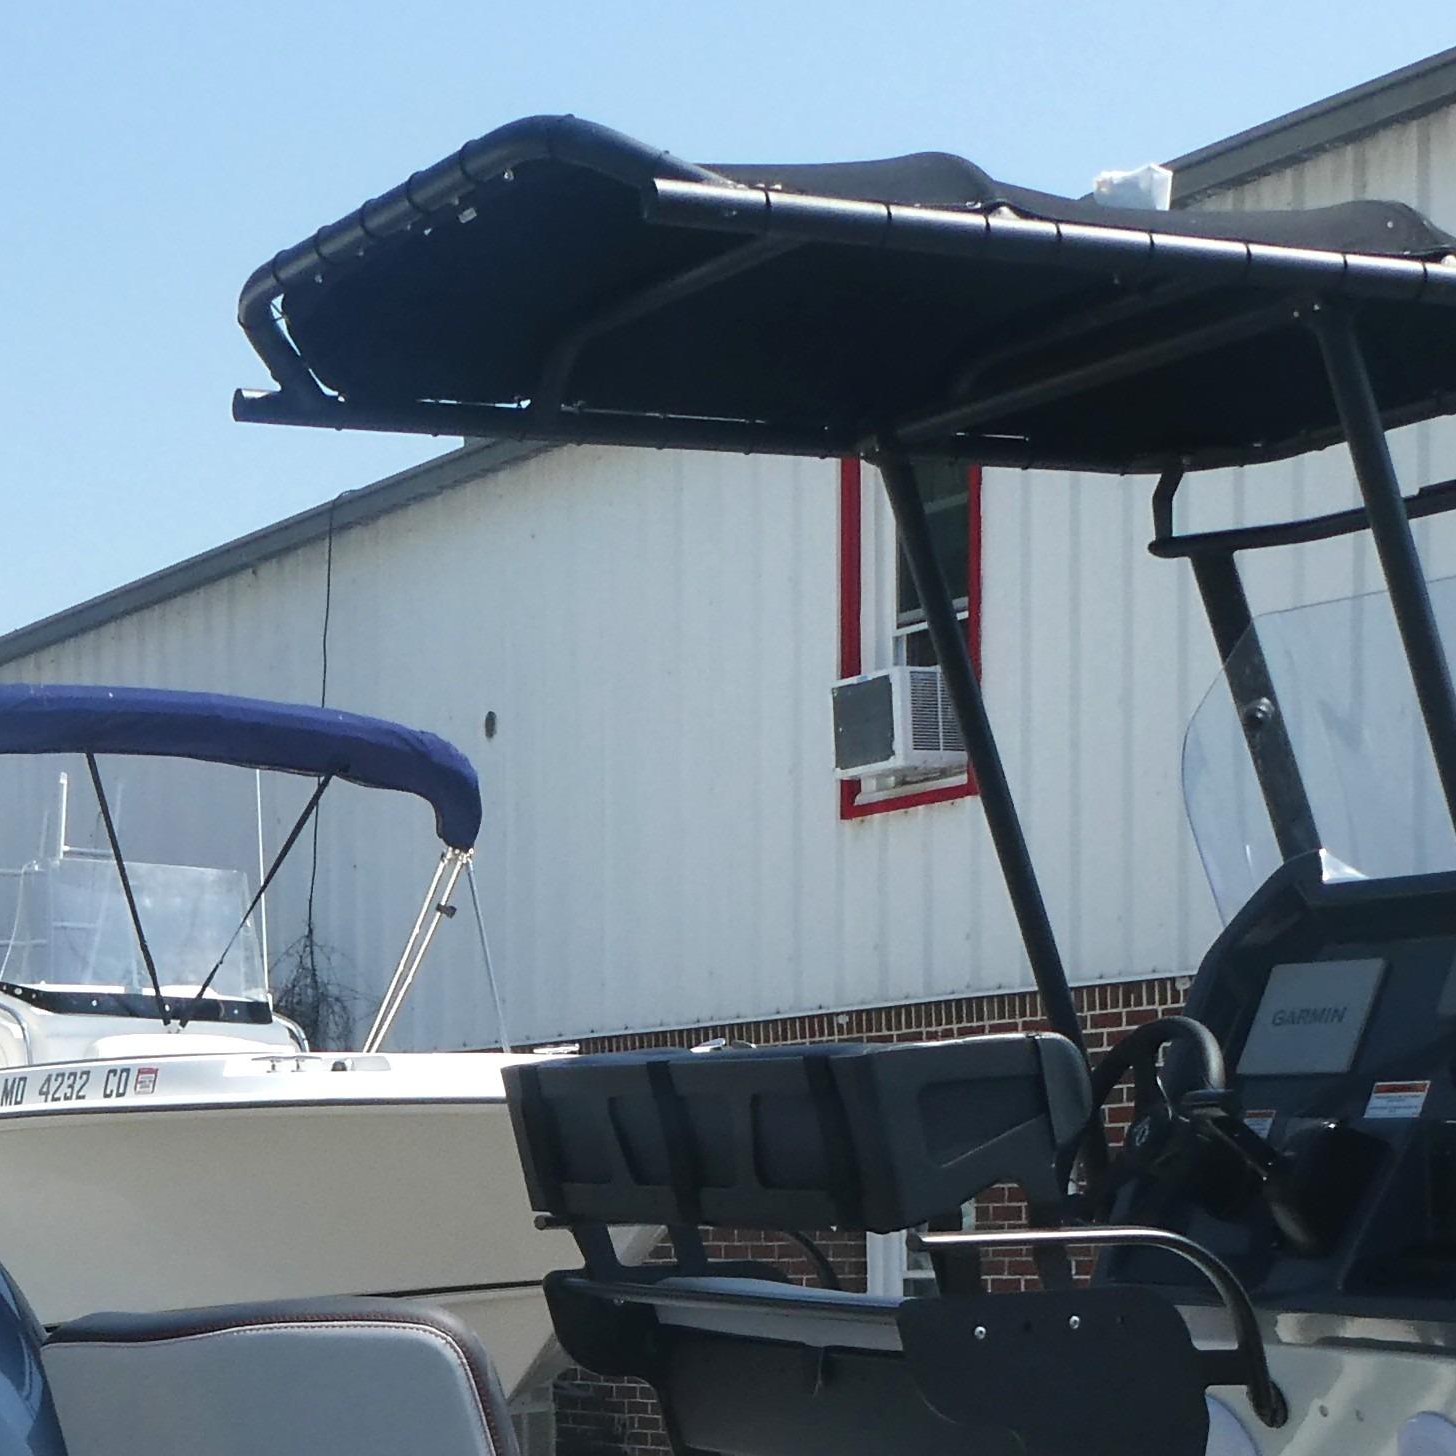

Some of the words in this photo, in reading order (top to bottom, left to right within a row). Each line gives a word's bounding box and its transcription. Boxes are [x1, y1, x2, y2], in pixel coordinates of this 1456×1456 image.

[1271, 1006, 1348, 1027] GARMIN
[0, 1076, 28, 1107] MD
[38, 1070, 91, 1104] 4232
